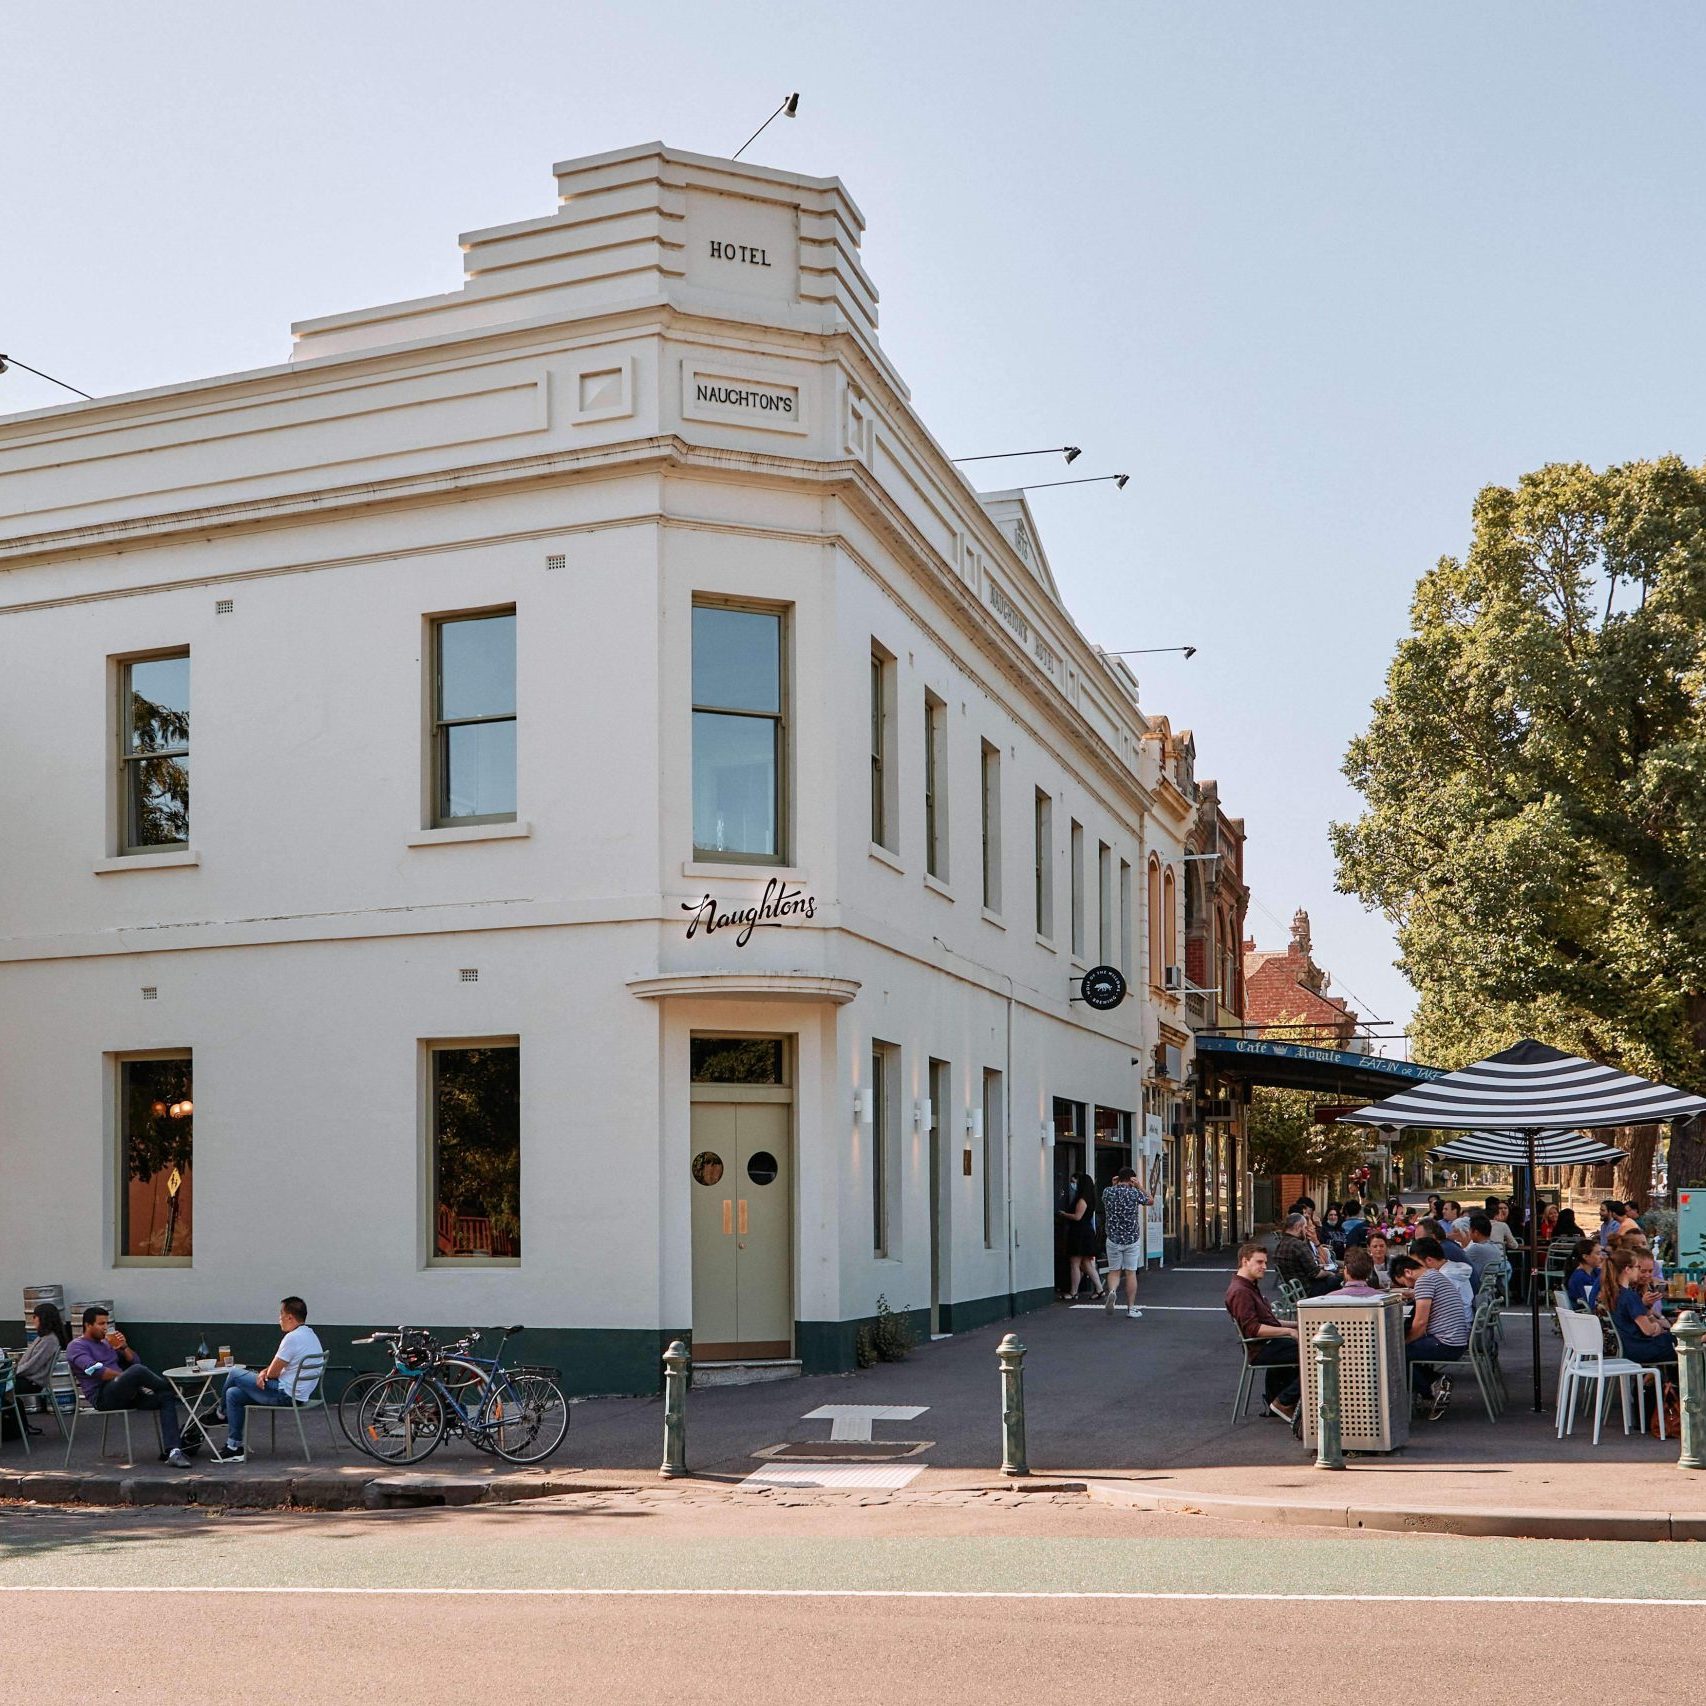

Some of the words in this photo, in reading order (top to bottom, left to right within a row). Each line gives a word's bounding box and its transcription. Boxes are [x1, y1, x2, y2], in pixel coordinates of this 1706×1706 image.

[709, 240, 772, 267] HOTEL
[681, 877, 818, 948] Naughtons
[1295, 1046, 1341, 1062] Royale
[1359, 1056, 1399, 1072] EAT-IN
